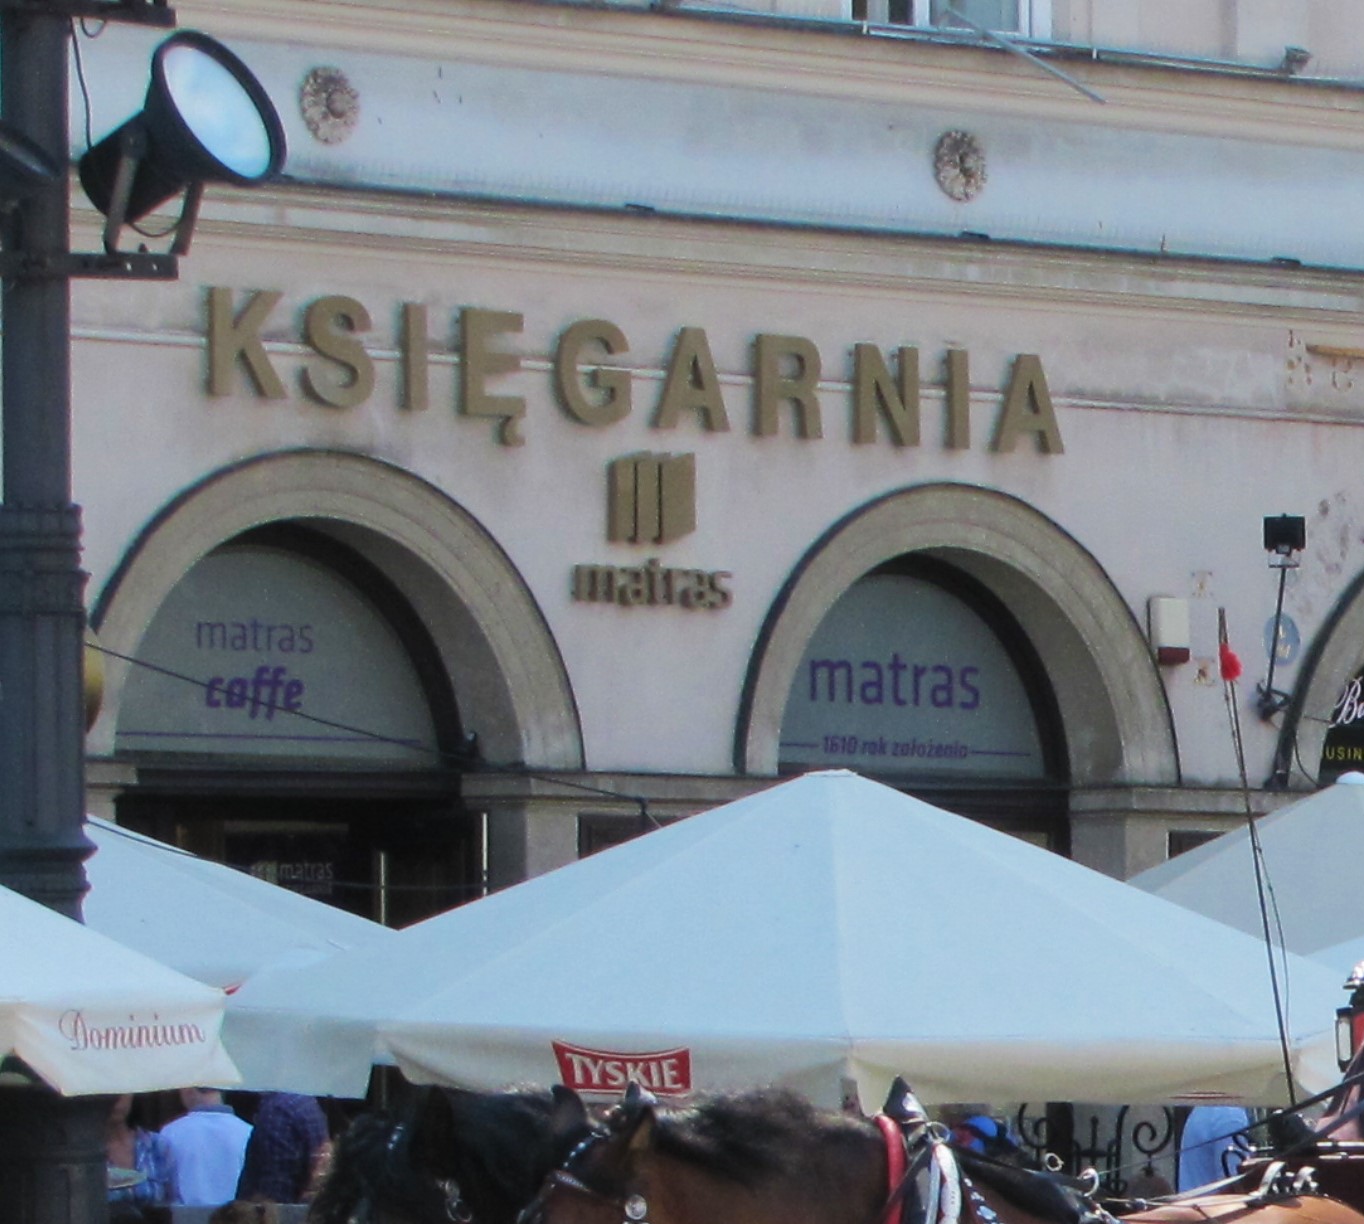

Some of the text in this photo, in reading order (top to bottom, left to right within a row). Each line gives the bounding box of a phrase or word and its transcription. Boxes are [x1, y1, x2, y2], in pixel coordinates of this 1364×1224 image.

[206, 286, 1064, 455] KSIĘGARNIA
[572, 559, 733, 610] matras
[196, 619, 314, 653] matras
[206, 665, 305, 719] caffe
[810, 653, 981, 710] matras
[279, 860, 334, 880] matras
[58, 1009, 206, 1051] Dominium
[564, 1053, 682, 1089] TYSKIE
